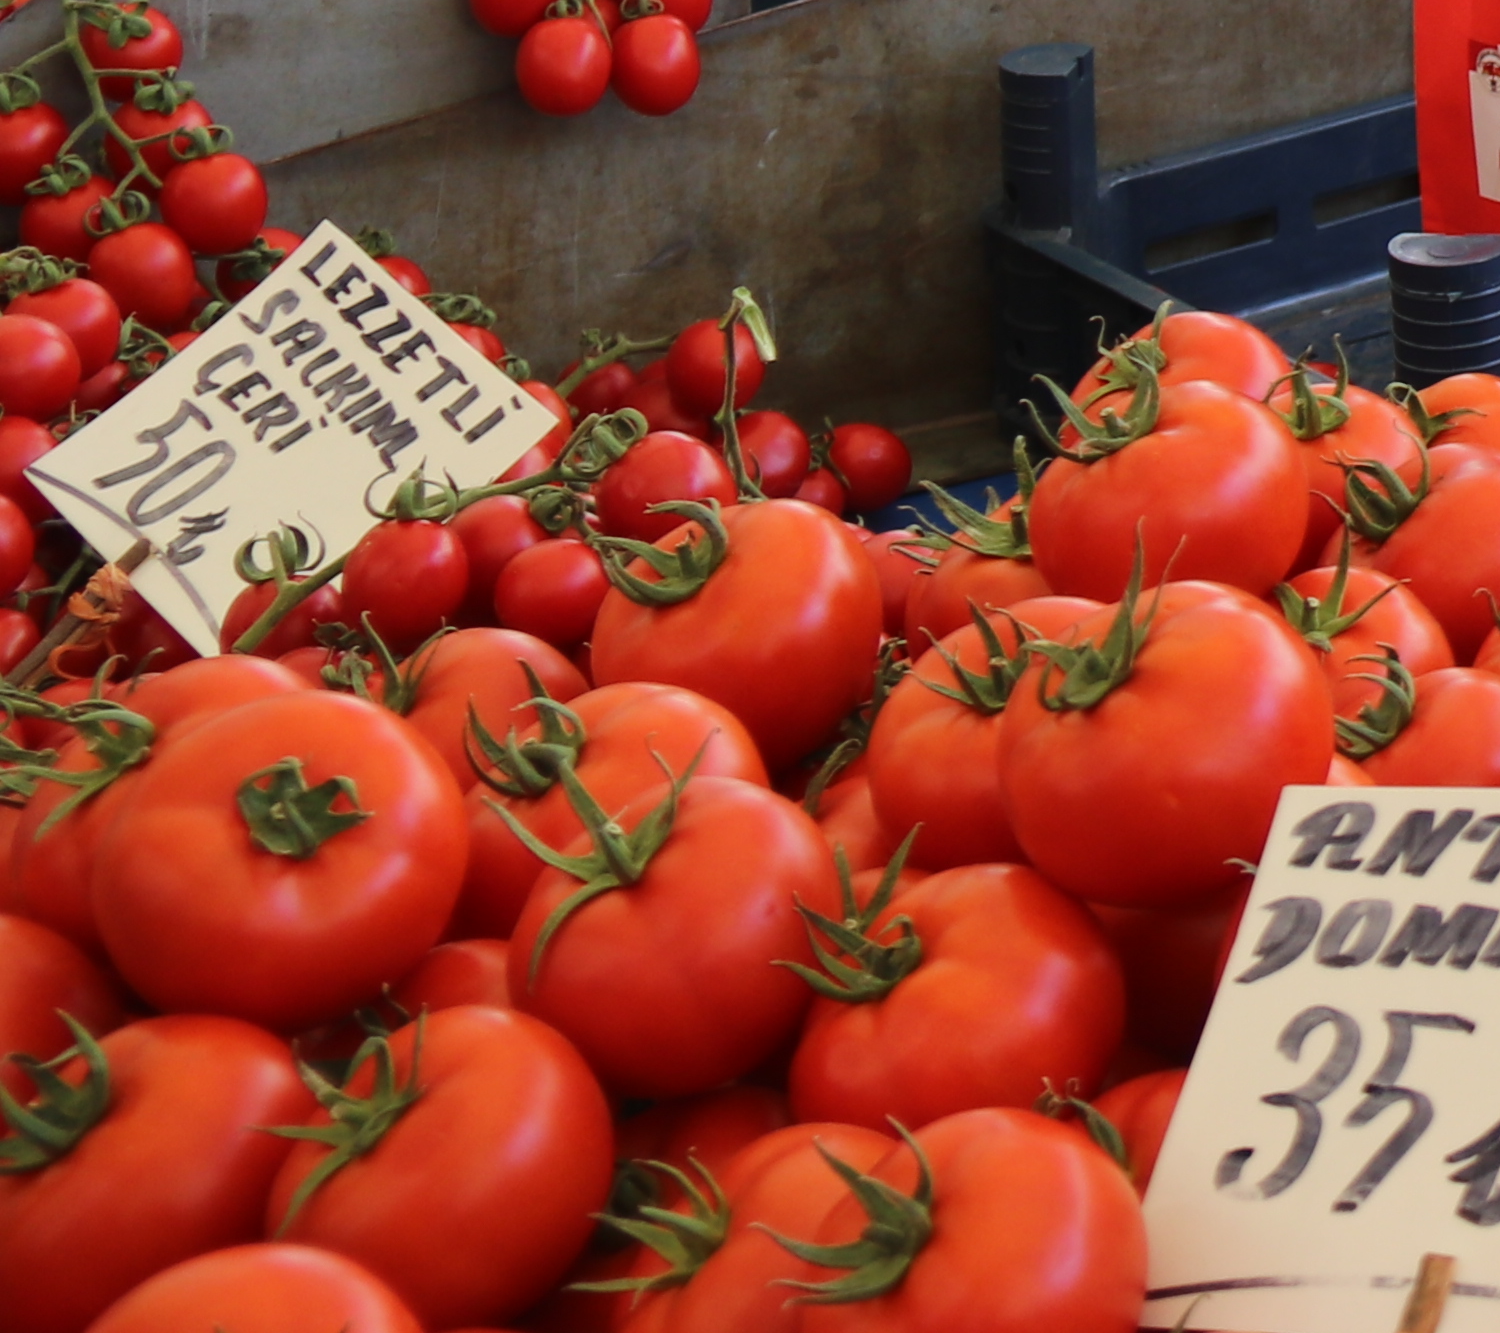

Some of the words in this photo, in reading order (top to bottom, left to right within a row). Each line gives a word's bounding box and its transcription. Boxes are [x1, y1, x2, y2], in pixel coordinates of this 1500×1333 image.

[193, 343, 331, 453] ÇERİ
[239, 288, 421, 472] SALKIM
[299, 240, 525, 446] LEZZETLİ
